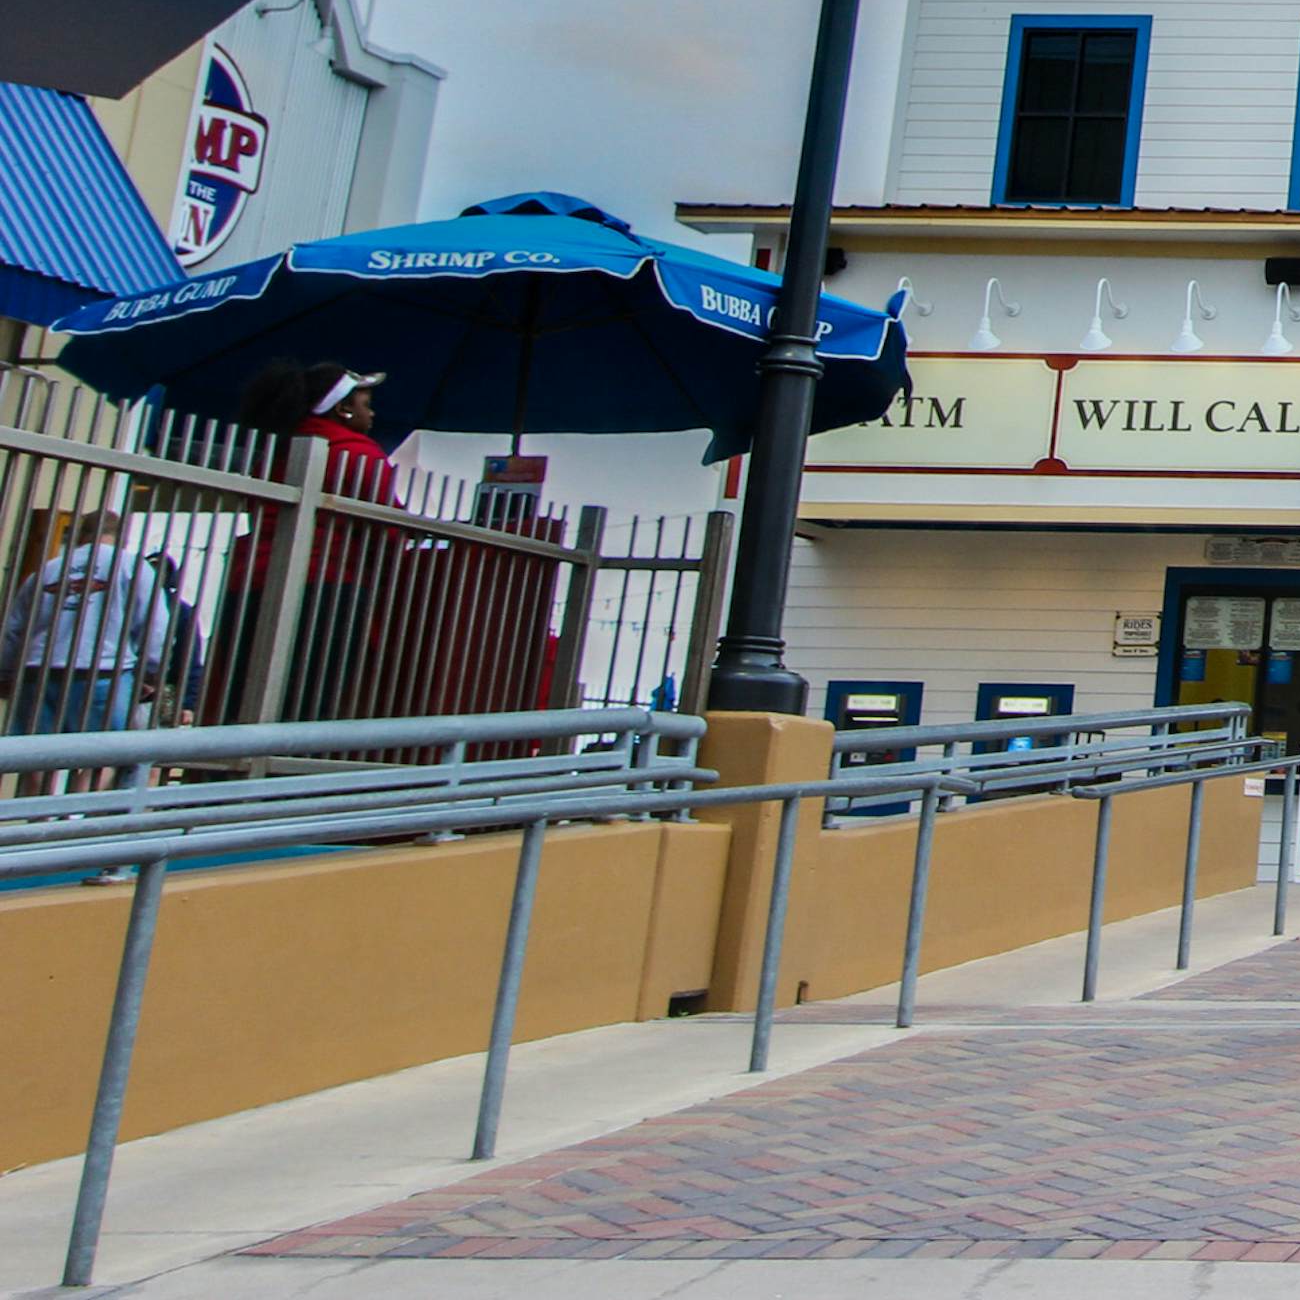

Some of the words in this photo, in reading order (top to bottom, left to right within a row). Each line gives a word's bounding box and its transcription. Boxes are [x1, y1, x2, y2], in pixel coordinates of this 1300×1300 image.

[188, 180, 217, 202] THE
[367, 249, 497, 271] SHRIMP
[173, 275, 238, 304] GUMP
[700, 283, 762, 326] BUBBA
[859, 396, 967, 429] TM
[1073, 399, 1193, 432] WILL
